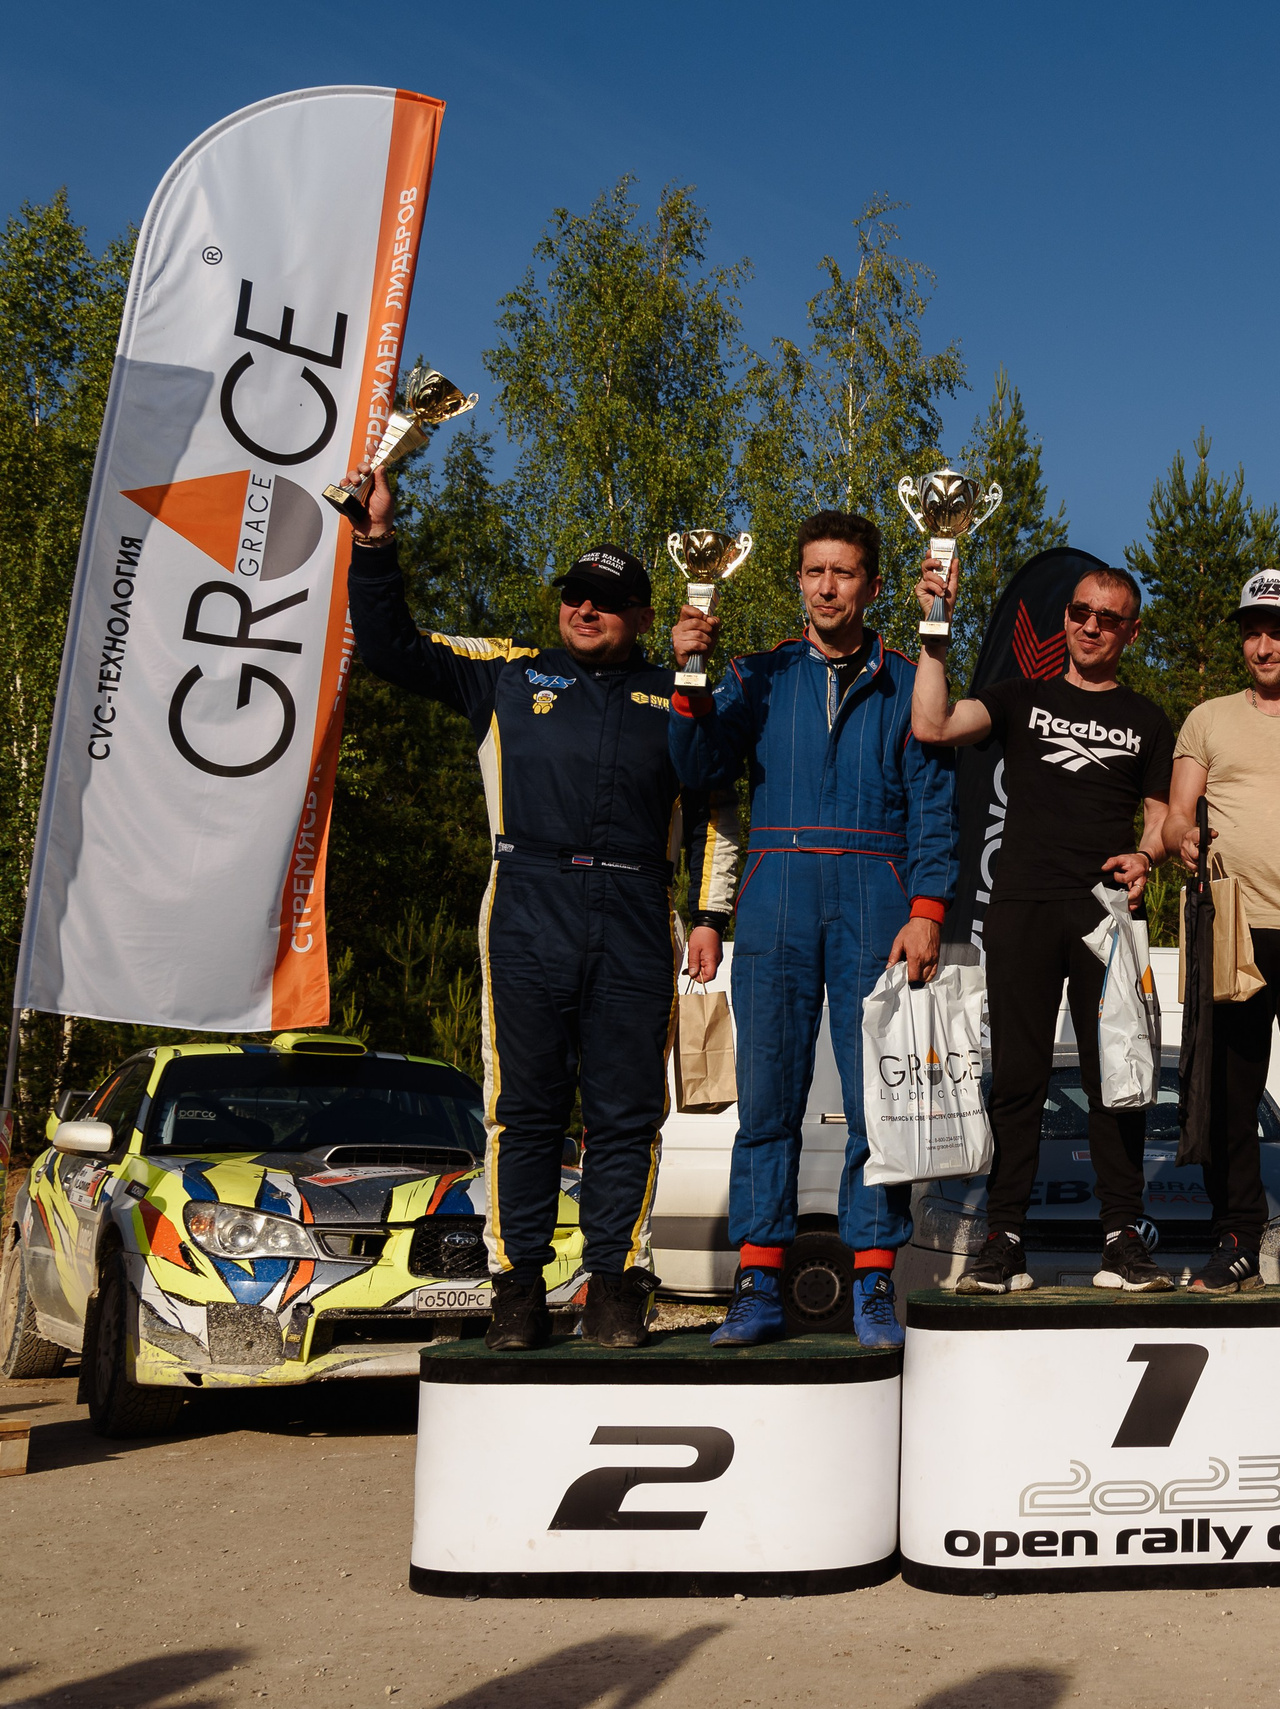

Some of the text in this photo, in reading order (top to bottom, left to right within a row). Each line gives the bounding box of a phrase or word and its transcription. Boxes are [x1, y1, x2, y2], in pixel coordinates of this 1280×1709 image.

[385, 186, 418, 310] ЛИДЕРОВ
[238, 473, 272, 576] GRACE
[600, 559, 624, 571] AGAIN
[601, 553, 626, 566] RALLY
[650, 694, 670, 709] SYR
[1028, 706, 1142, 755] Reebok
[178, 1109, 217, 1119] parco
[1111, 1342, 1209, 1448] 1
[547, 1425, 735, 1531] 2
[944, 1528, 1098, 1566] open
[1115, 1518, 1252, 1561] rally
